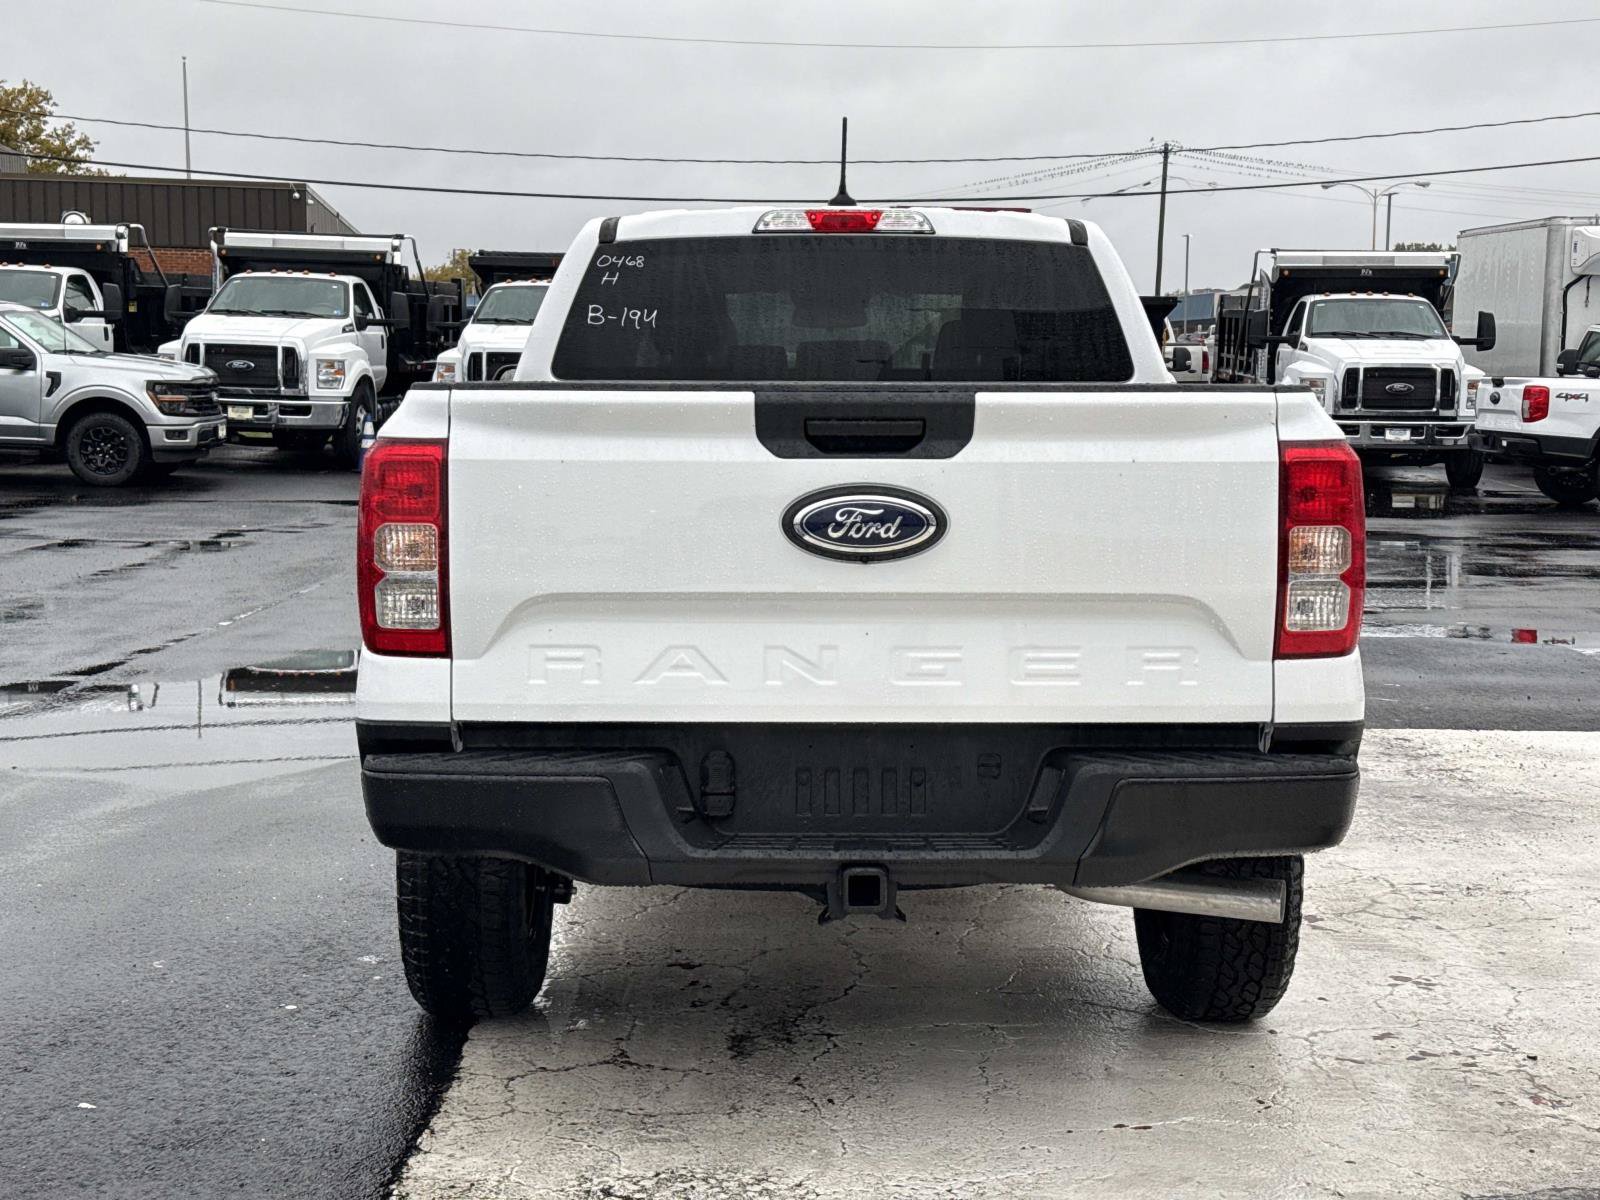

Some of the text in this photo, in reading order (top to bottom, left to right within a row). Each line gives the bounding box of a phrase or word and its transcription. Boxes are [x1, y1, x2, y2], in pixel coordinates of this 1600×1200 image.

[597, 254, 645, 268] 0468
[601, 271, 620, 286] H
[587, 304, 658, 330] B-194
[827, 507, 903, 539] Ford
[527, 643, 1200, 687] RANGER
